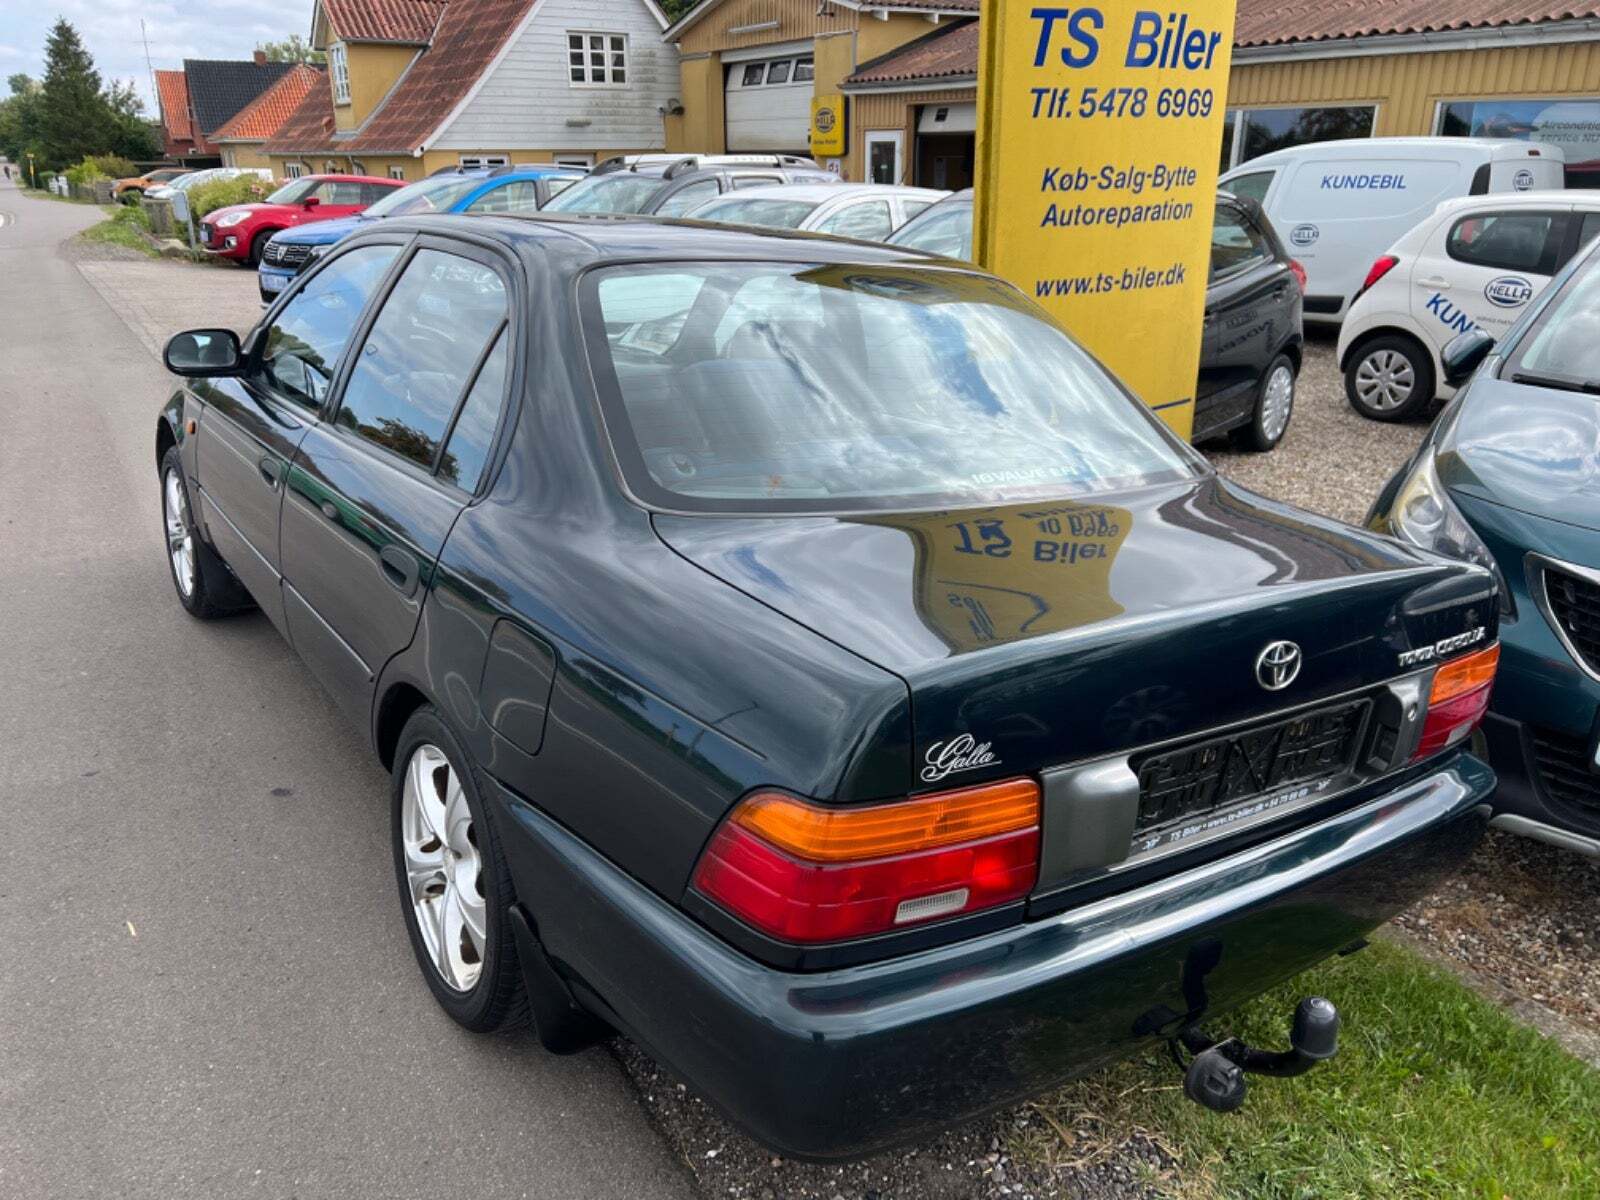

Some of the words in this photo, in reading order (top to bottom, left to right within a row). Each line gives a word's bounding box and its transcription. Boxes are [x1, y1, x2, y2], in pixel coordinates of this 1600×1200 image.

[1030, 8, 1104, 69] TS
[1124, 11, 1222, 70] Biler
[1030, 87, 1072, 118] Tlf.
[1079, 87, 1148, 118] 5478
[1157, 88, 1214, 118] 6969
[1041, 165, 1197, 194] Køb-Salg-Bytte
[1320, 174, 1407, 189] KUNDEBIL
[1040, 198, 1193, 228] Autoreparation
[1036, 264, 1186, 297] www.ts-biler.dk
[1488, 284, 1533, 300] HELLA
[1425, 292, 1481, 334] KUN
[920, 733, 1002, 782] Galla
